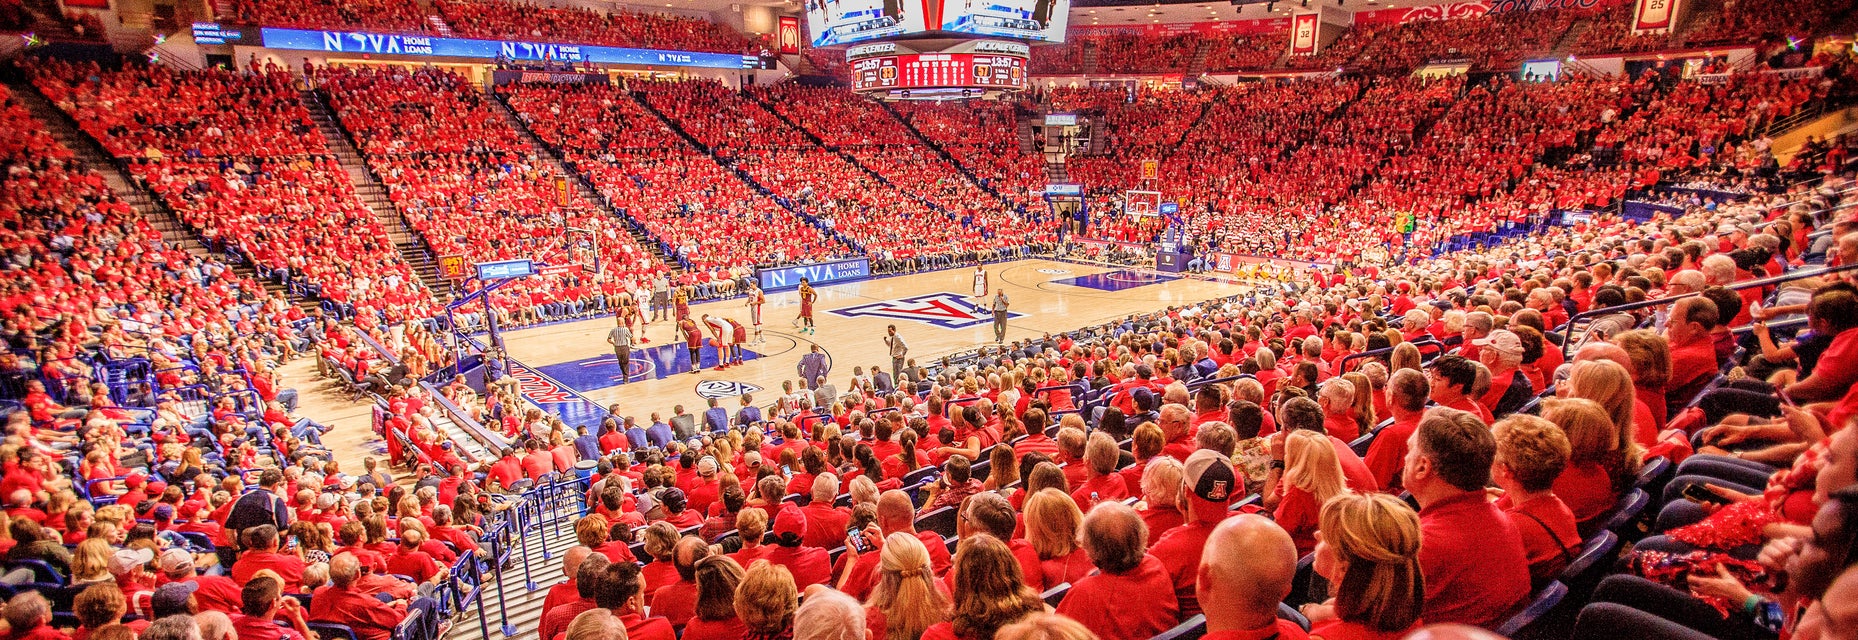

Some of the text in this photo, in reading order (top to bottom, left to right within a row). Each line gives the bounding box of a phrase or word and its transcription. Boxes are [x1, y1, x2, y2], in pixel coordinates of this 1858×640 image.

[1650, 0, 1664, 9] 25
[1300, 30, 1310, 38] 32
[403, 36, 431, 46] HOME
[404, 45, 432, 54] LOANS
[560, 45, 580, 53] HOME
[882, 67, 894, 79] 33
[977, 65, 989, 77] 57
[838, 262, 860, 271] HOME
[838, 269, 861, 278] LOANS
[1208, 480, 1227, 499] A
